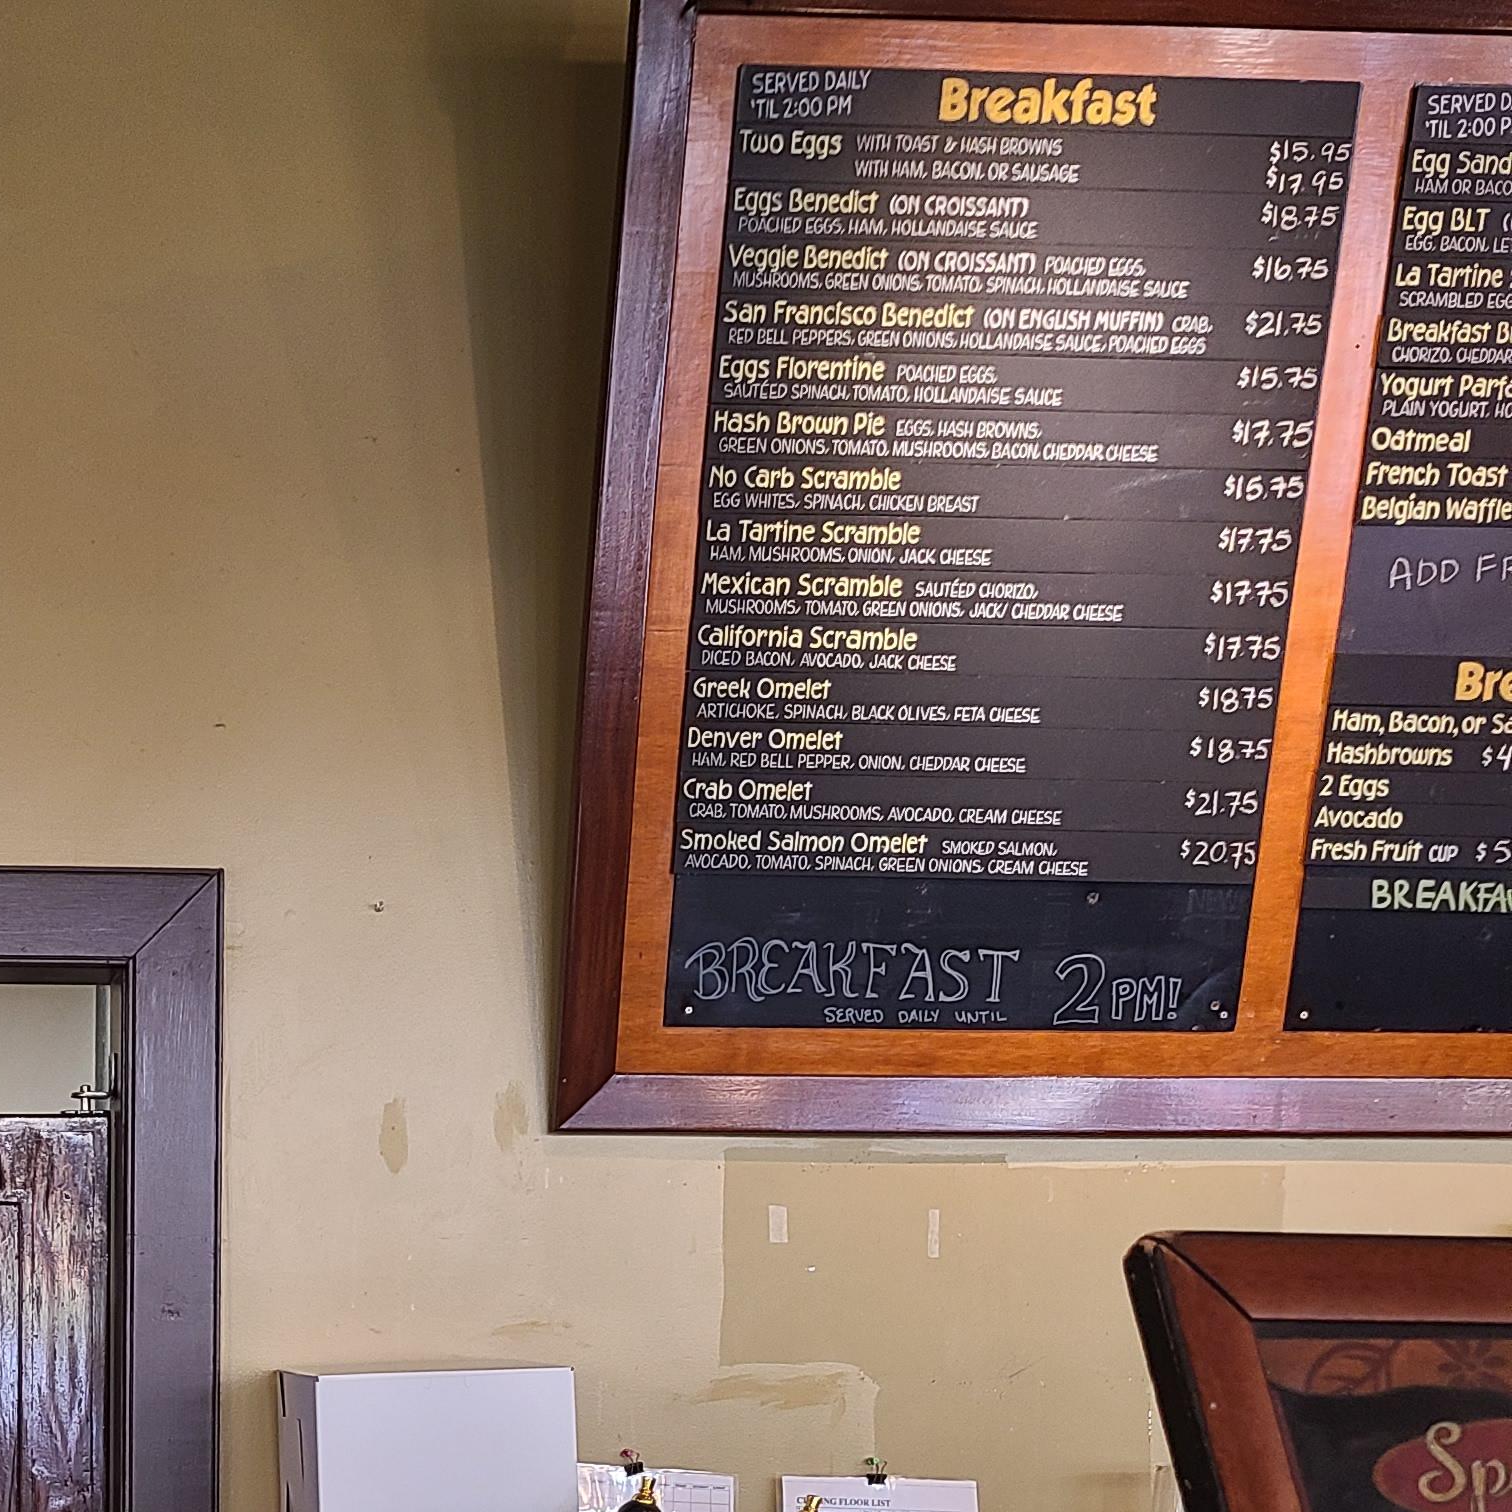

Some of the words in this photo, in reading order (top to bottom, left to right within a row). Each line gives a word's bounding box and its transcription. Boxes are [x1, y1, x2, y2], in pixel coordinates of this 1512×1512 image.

[752, 71, 819, 94] SERVED
[825, 69, 871, 92] DAILY
[783, 96, 823, 117] 2:00
[826, 95, 853, 116] PM
[938, 77, 1158, 127] Breakfast
[1428, 93, 1496, 115] SERVED
[1456, 118, 1496, 139] 2:00
[739, 129, 784, 154] Two
[790, 130, 843, 160] Eggs
[855, 134, 891, 153] WITH
[895, 134, 938, 153] TOAST
[960, 137, 997, 154] HASH
[999, 137, 1063, 157] BROWNS
[855, 160, 889, 177] WITH
[988, 162, 1008, 181] OR
[1011, 162, 1082, 184] SAUSAGE
[1411, 149, 1451, 179] Egg
[1415, 178, 1448, 194] HAM
[1452, 179, 1472, 194] OR
[733, 187, 782, 215] Eggs
[789, 188, 880, 215] Benedict
[1402, 206, 1444, 236] Egg
[1450, 208, 1490, 232] BLT
[728, 244, 800, 272] Veggie
[804, 246, 889, 271] Benedict
[1395, 263, 1421, 287] La
[1427, 264, 1504, 288] Tartine
[1399, 292, 1484, 308] SCRAMBLED
[723, 301, 767, 324] San
[773, 301, 876, 326] Francisco
[882, 302, 975, 329] Benedict
[1019, 309, 1091, 331] ENGLISH
[1387, 318, 1491, 344] Breakfast
[719, 355, 770, 383] Eggs
[777, 355, 886, 383] Florentine
[1381, 372, 1454, 400] Yogurt
[1382, 400, 1426, 416] PLAIN
[713, 410, 770, 434] Hash
[777, 412, 849, 436] Brown
[853, 413, 886, 436] Pie
[1372, 426, 1472, 452] Oatmeal
[709, 465, 737, 488] No
[744, 465, 794, 489] Carb
[801, 466, 902, 490] Scramble
[1366, 462, 1440, 486] French
[1447, 462, 1509, 488] Toast
[713, 494, 740, 508] EGG
[869, 495, 925, 511] CHICKEN
[927, 496, 979, 513] BREAST
[1361, 492, 1440, 526] Belgian
[706, 520, 731, 542] La
[739, 520, 816, 542] Tartine
[820, 521, 921, 545] Scramble
[700, 572, 791, 596] Mexican
[796, 573, 903, 597] Scramble
[1389, 556, 1460, 591] ADD
[697, 625, 803, 649] California
[809, 626, 918, 651] Scramble
[701, 651, 742, 666] DICED
[869, 655, 904, 670] JACK
[907, 656, 956, 671] CHEESE
[693, 677, 751, 699] Greek
[757, 678, 832, 700] Omelet
[1462, 716, 1487, 734] or
[688, 727, 763, 748] Denver
[768, 728, 843, 751] Omelet
[1326, 741, 1453, 766] Hashbrowns
[683, 779, 733, 799] Crab
[738, 779, 812, 801] Omelet
[1319, 774, 1334, 797] 2
[1338, 774, 1390, 801] Eggs
[1314, 805, 1404, 829] Avocado
[680, 829, 761, 850] Smoked
[767, 830, 844, 852] Salmon
[850, 832, 928, 854] Omelet
[1310, 838, 1367, 861] Fresh
[1371, 839, 1424, 862] Fruit
[1428, 844, 1459, 862] CUP
[684, 936, 1021, 1003] BREAKFAST
[1052, 953, 1107, 1027] 2
[1111, 975, 1183, 1021] PM!
[824, 1007, 885, 1025] SERVED
[898, 1008, 941, 1025] DAILY
[954, 1009, 1007, 1024] UNTIL
[839, 1497, 869, 1506] FLOOR
[872, 1499, 891, 1507] LIST
